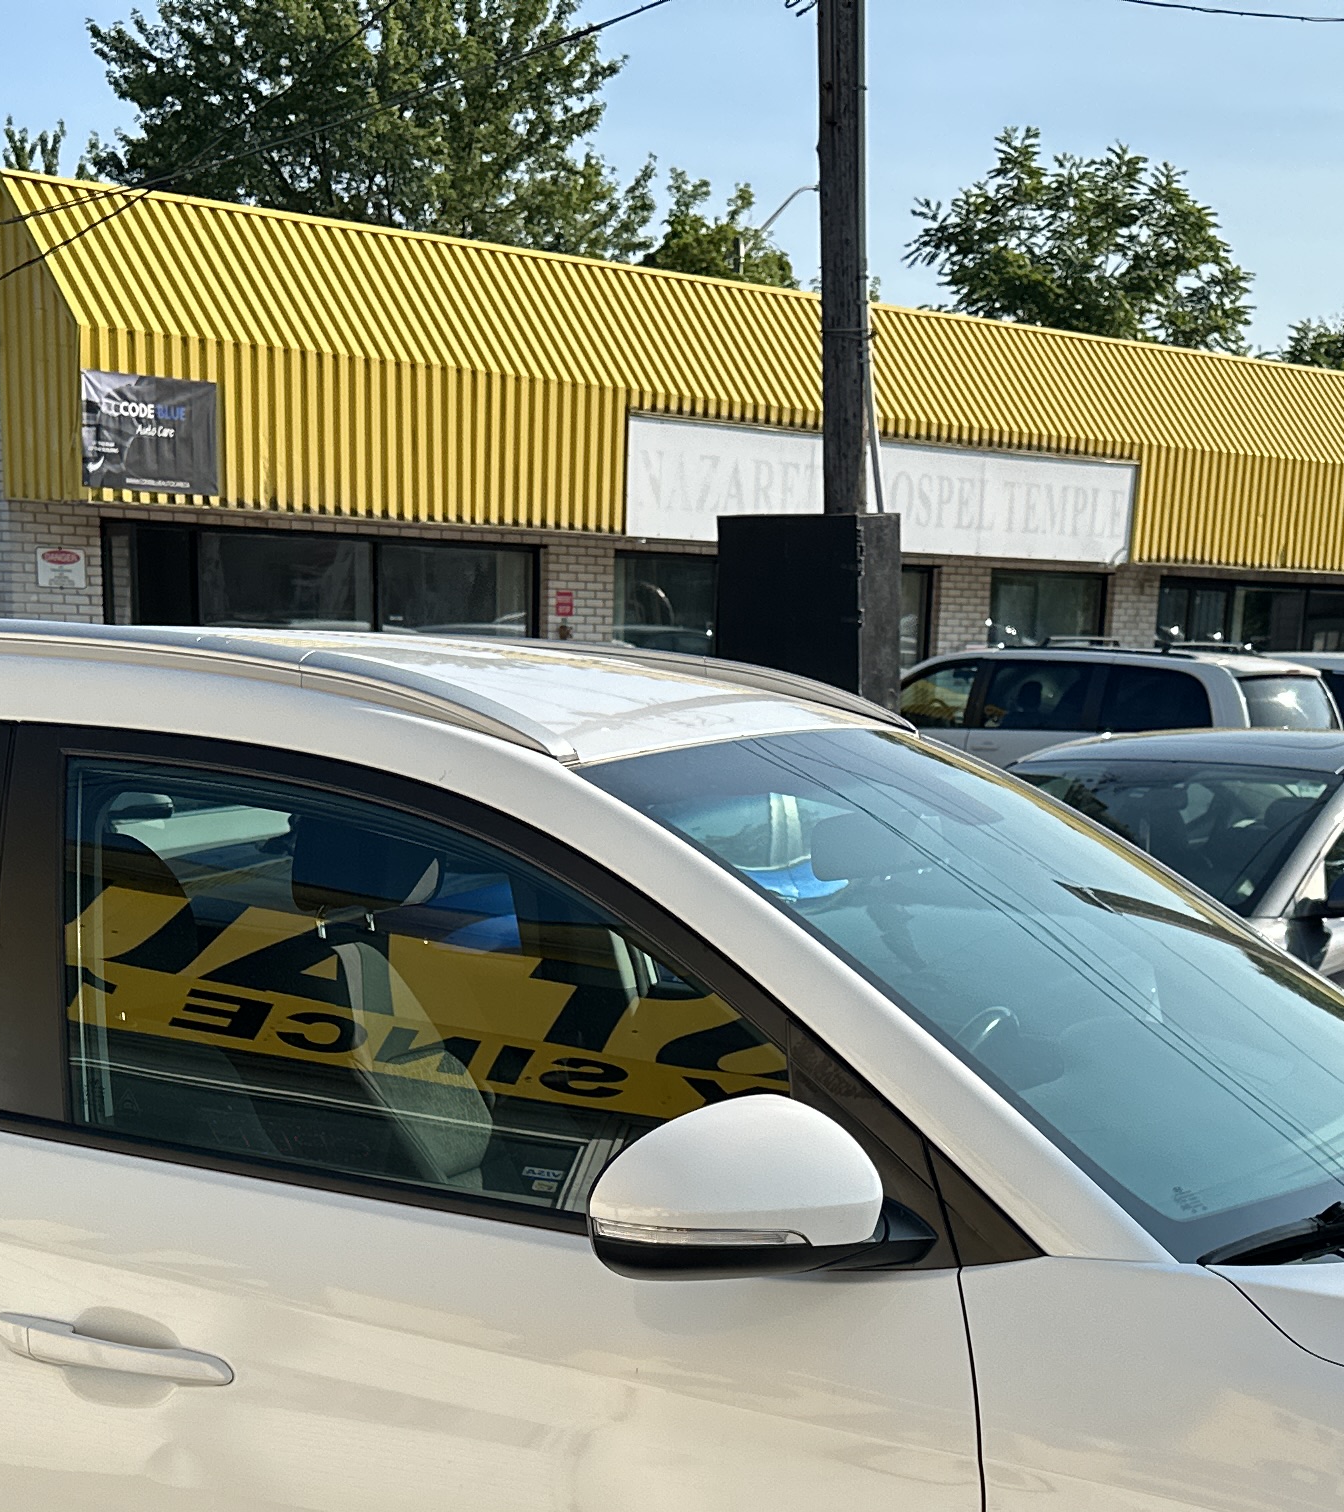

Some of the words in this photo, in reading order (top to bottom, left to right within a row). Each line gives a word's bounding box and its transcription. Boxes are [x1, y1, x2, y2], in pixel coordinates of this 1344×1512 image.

[638, 448, 821, 512] NAZARET
[889, 469, 997, 531] OSPEL
[1002, 480, 1125, 539] TEMPLE
